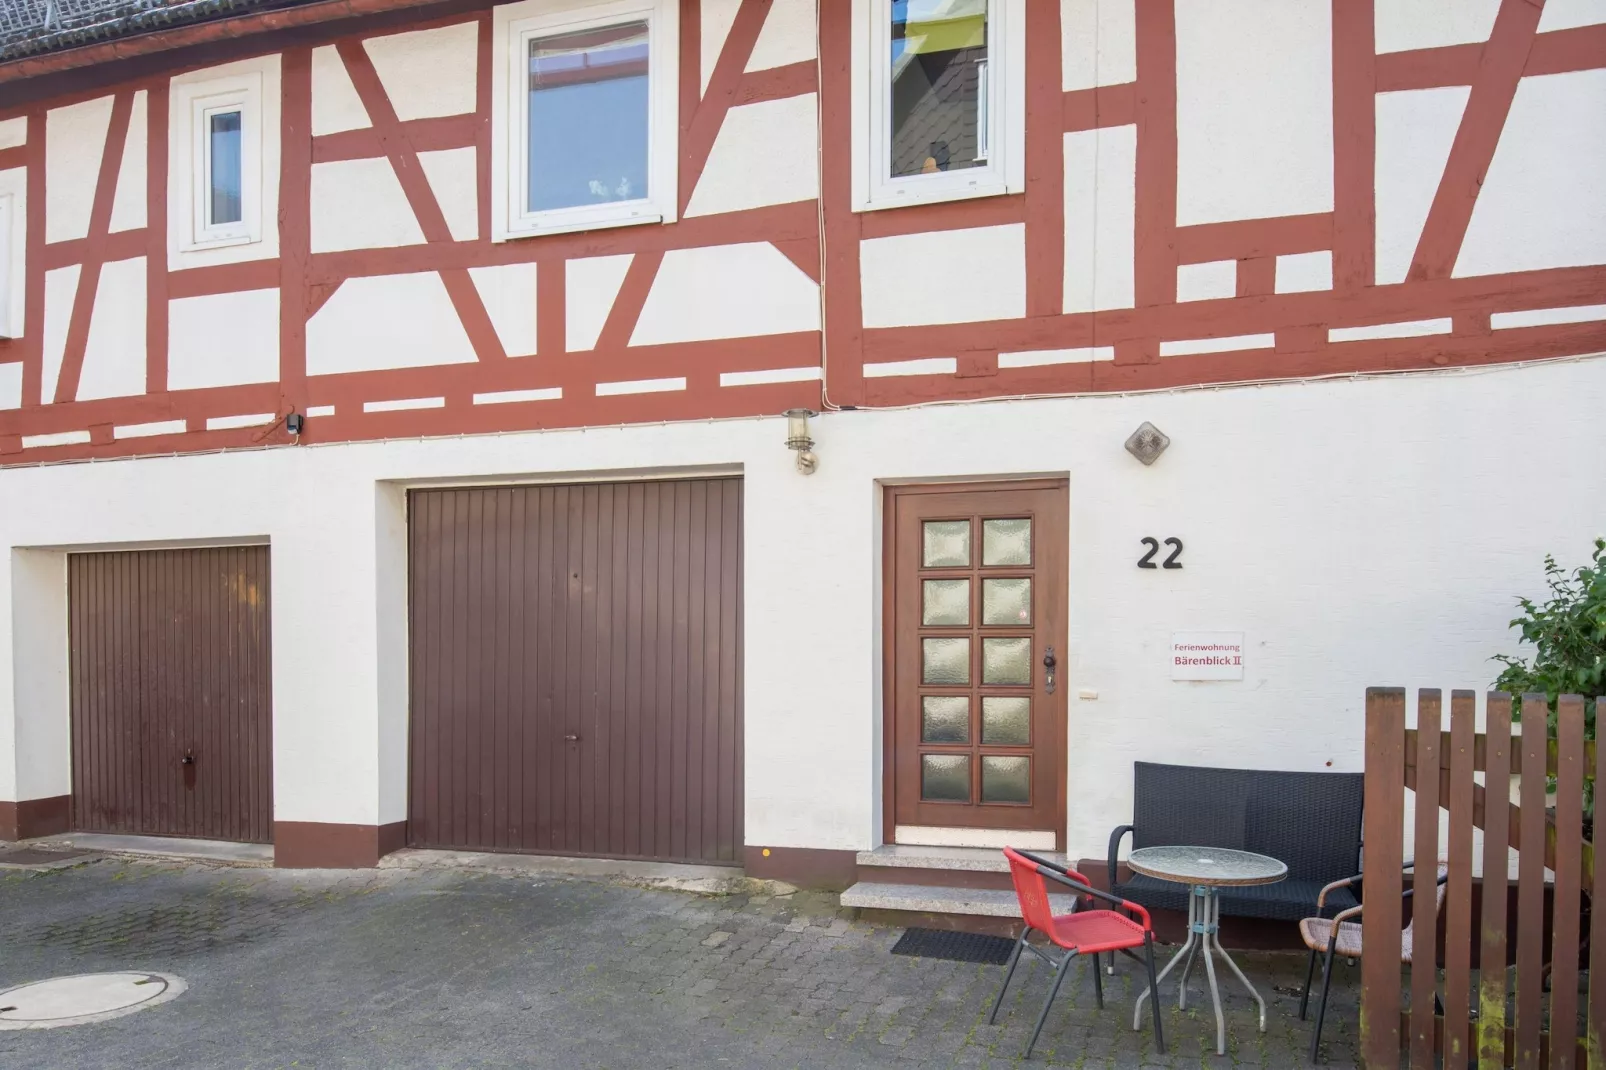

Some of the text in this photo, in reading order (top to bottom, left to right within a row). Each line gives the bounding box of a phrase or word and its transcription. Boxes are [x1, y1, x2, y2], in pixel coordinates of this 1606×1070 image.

[1137, 536, 1183, 569] 22
[1174, 643, 1240, 652] Ferienwohnung
[1174, 655, 1231, 666] Bärenblick
